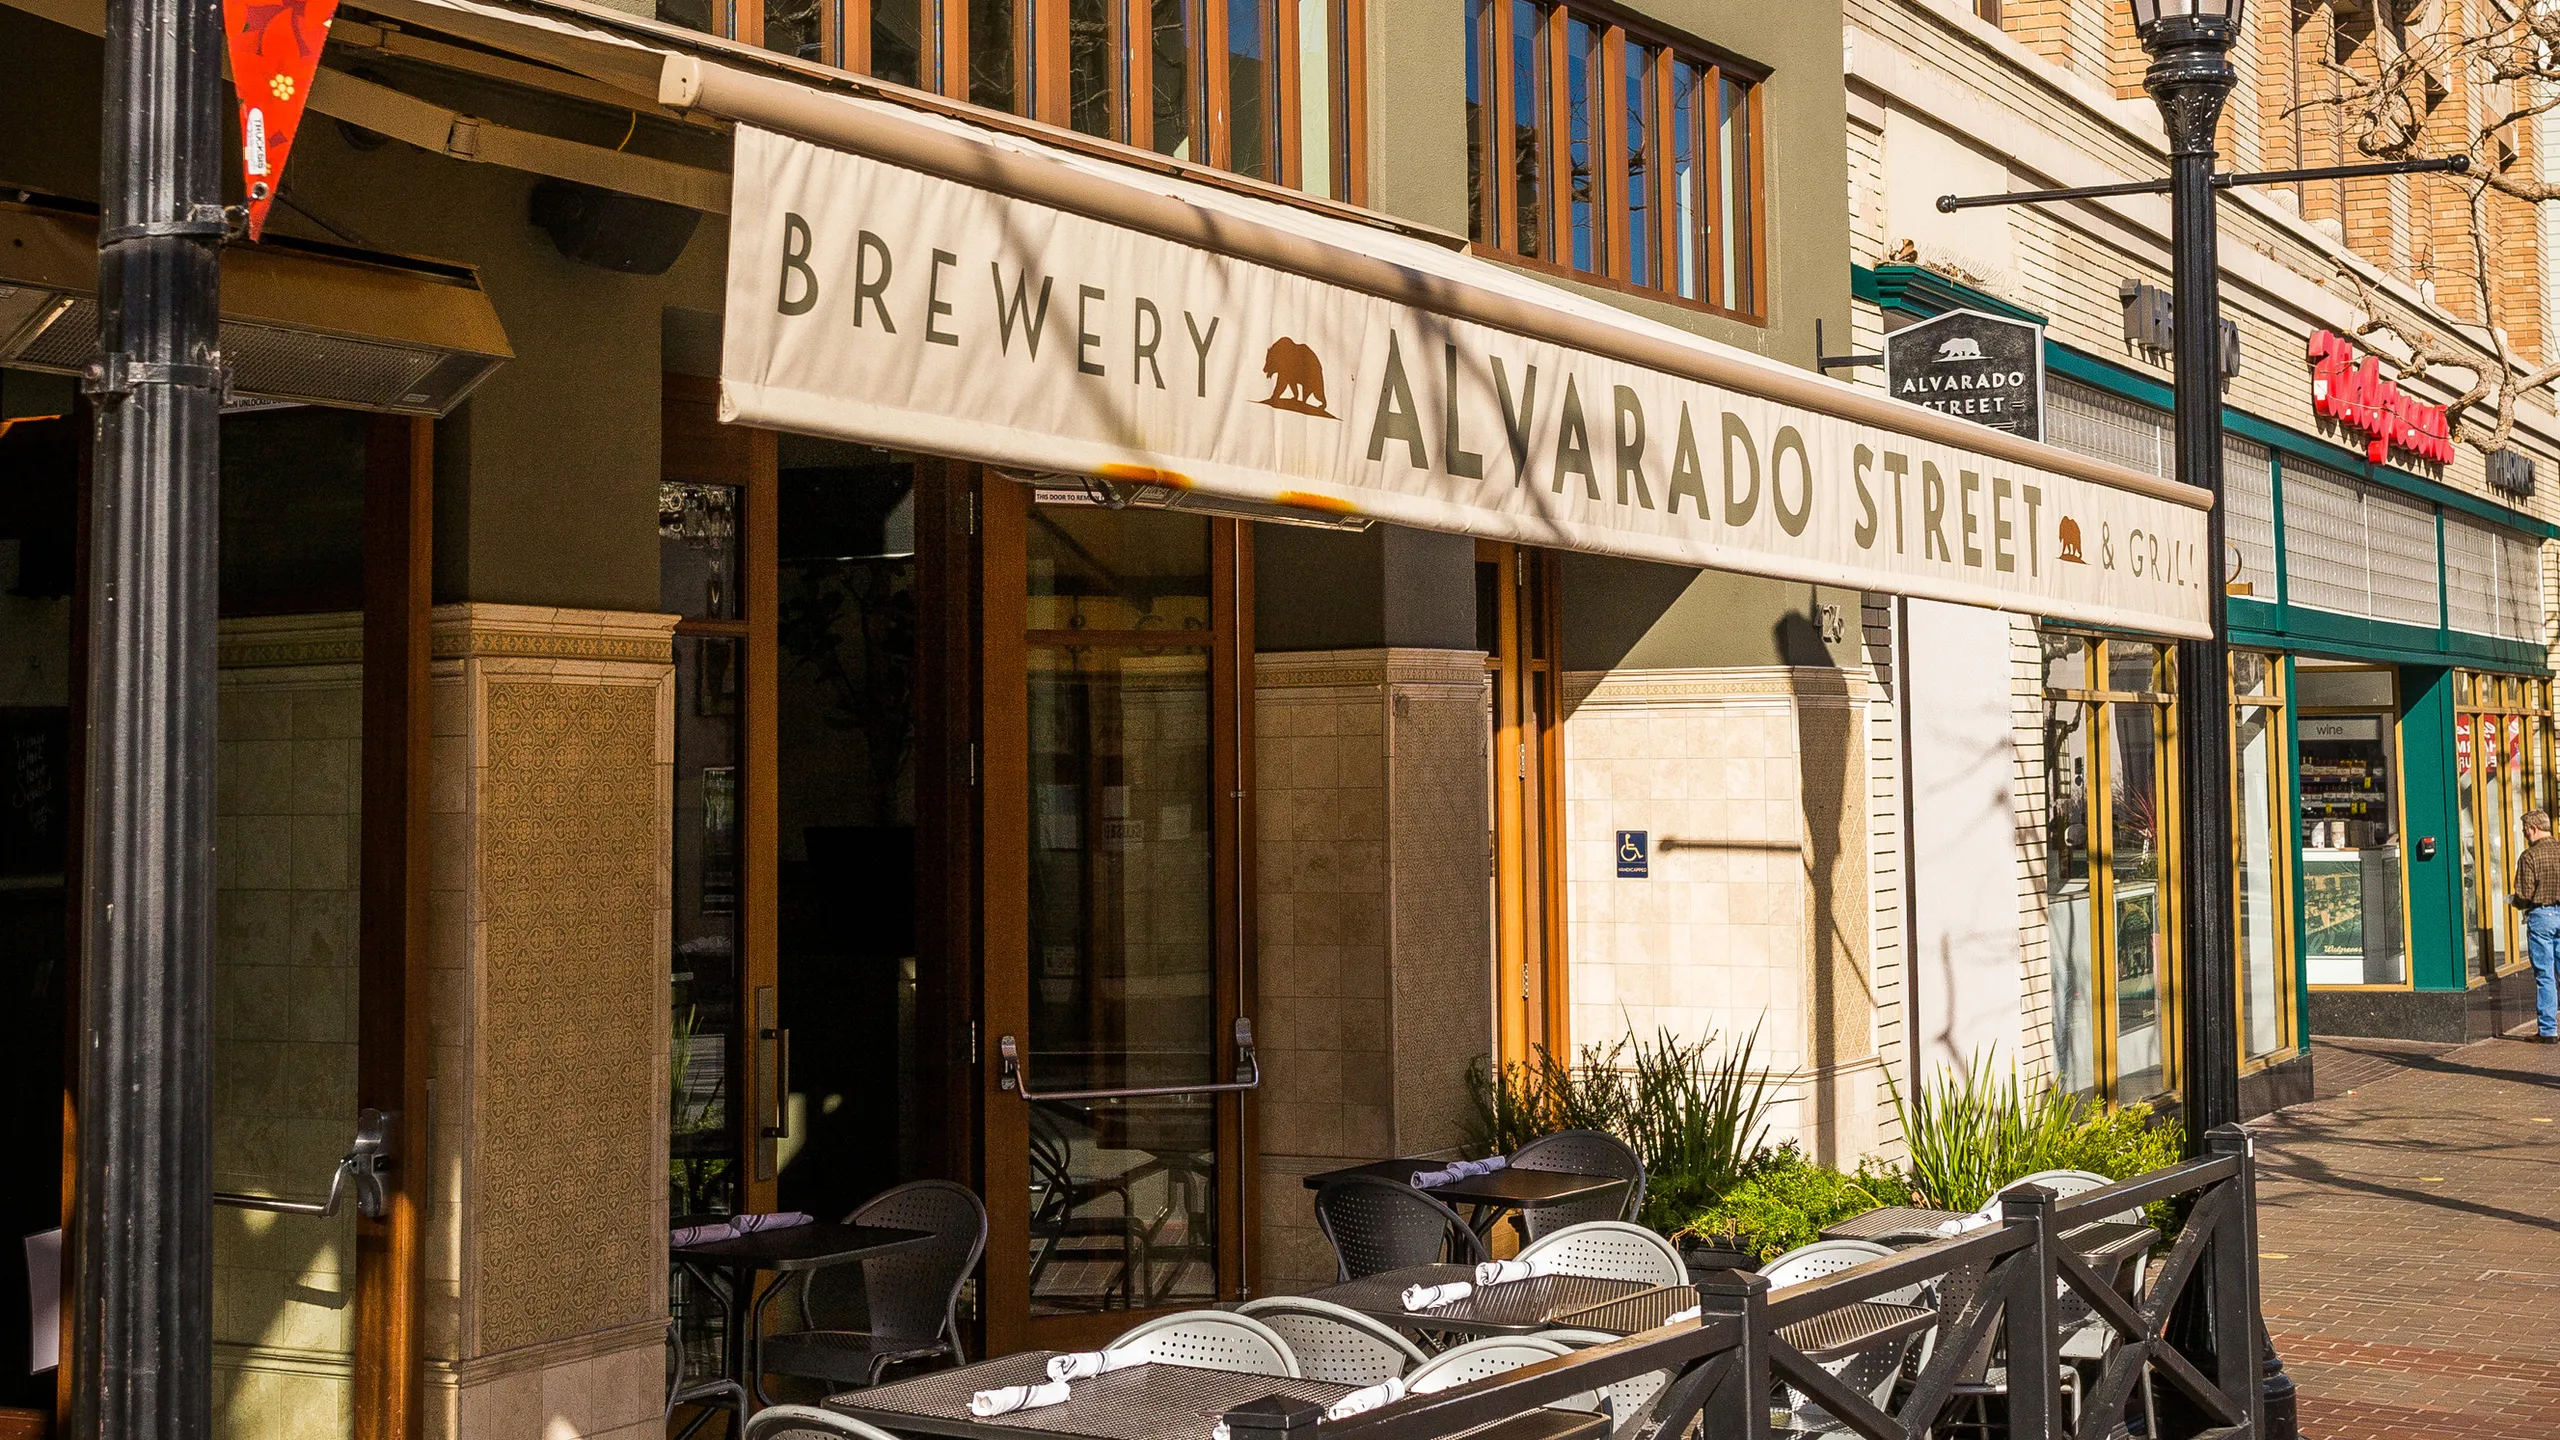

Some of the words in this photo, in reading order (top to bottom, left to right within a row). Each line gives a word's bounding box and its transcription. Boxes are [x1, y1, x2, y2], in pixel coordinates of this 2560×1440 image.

[1902, 371, 2025, 394] ALVARADO
[777, 212, 1220, 398] BREWERY
[1366, 328, 1813, 537] ALVARADO
[1853, 443, 2042, 578] STREET
[2101, 520, 2116, 571] &
[1036, 493, 1049, 501] THIS
[2316, 724, 2344, 735] wine
